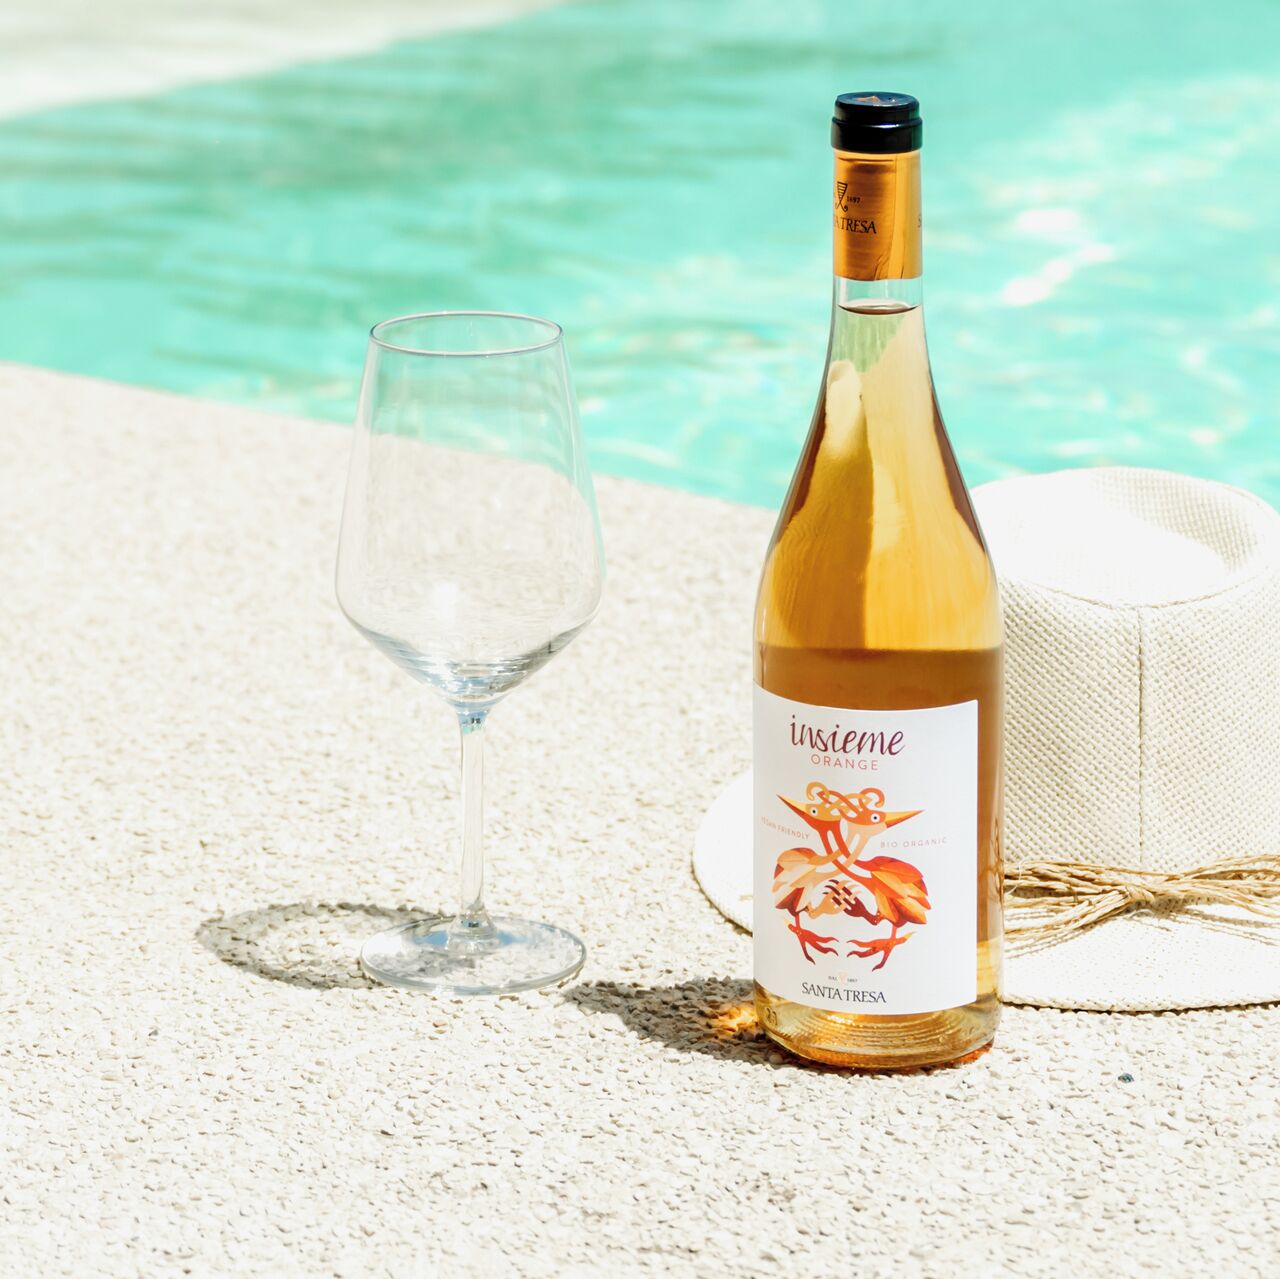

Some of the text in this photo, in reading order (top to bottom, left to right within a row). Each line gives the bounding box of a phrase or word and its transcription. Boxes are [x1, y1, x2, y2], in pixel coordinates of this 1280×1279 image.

[841, 217, 877, 234] TRESA
[790, 714, 905, 756] insieme
[811, 754, 878, 770] ORANGE
[777, 825, 809, 840] FRIENDLY
[880, 836, 947, 848] BIO ORGANIC
[802, 982, 887, 1003] SANTA TRESA
